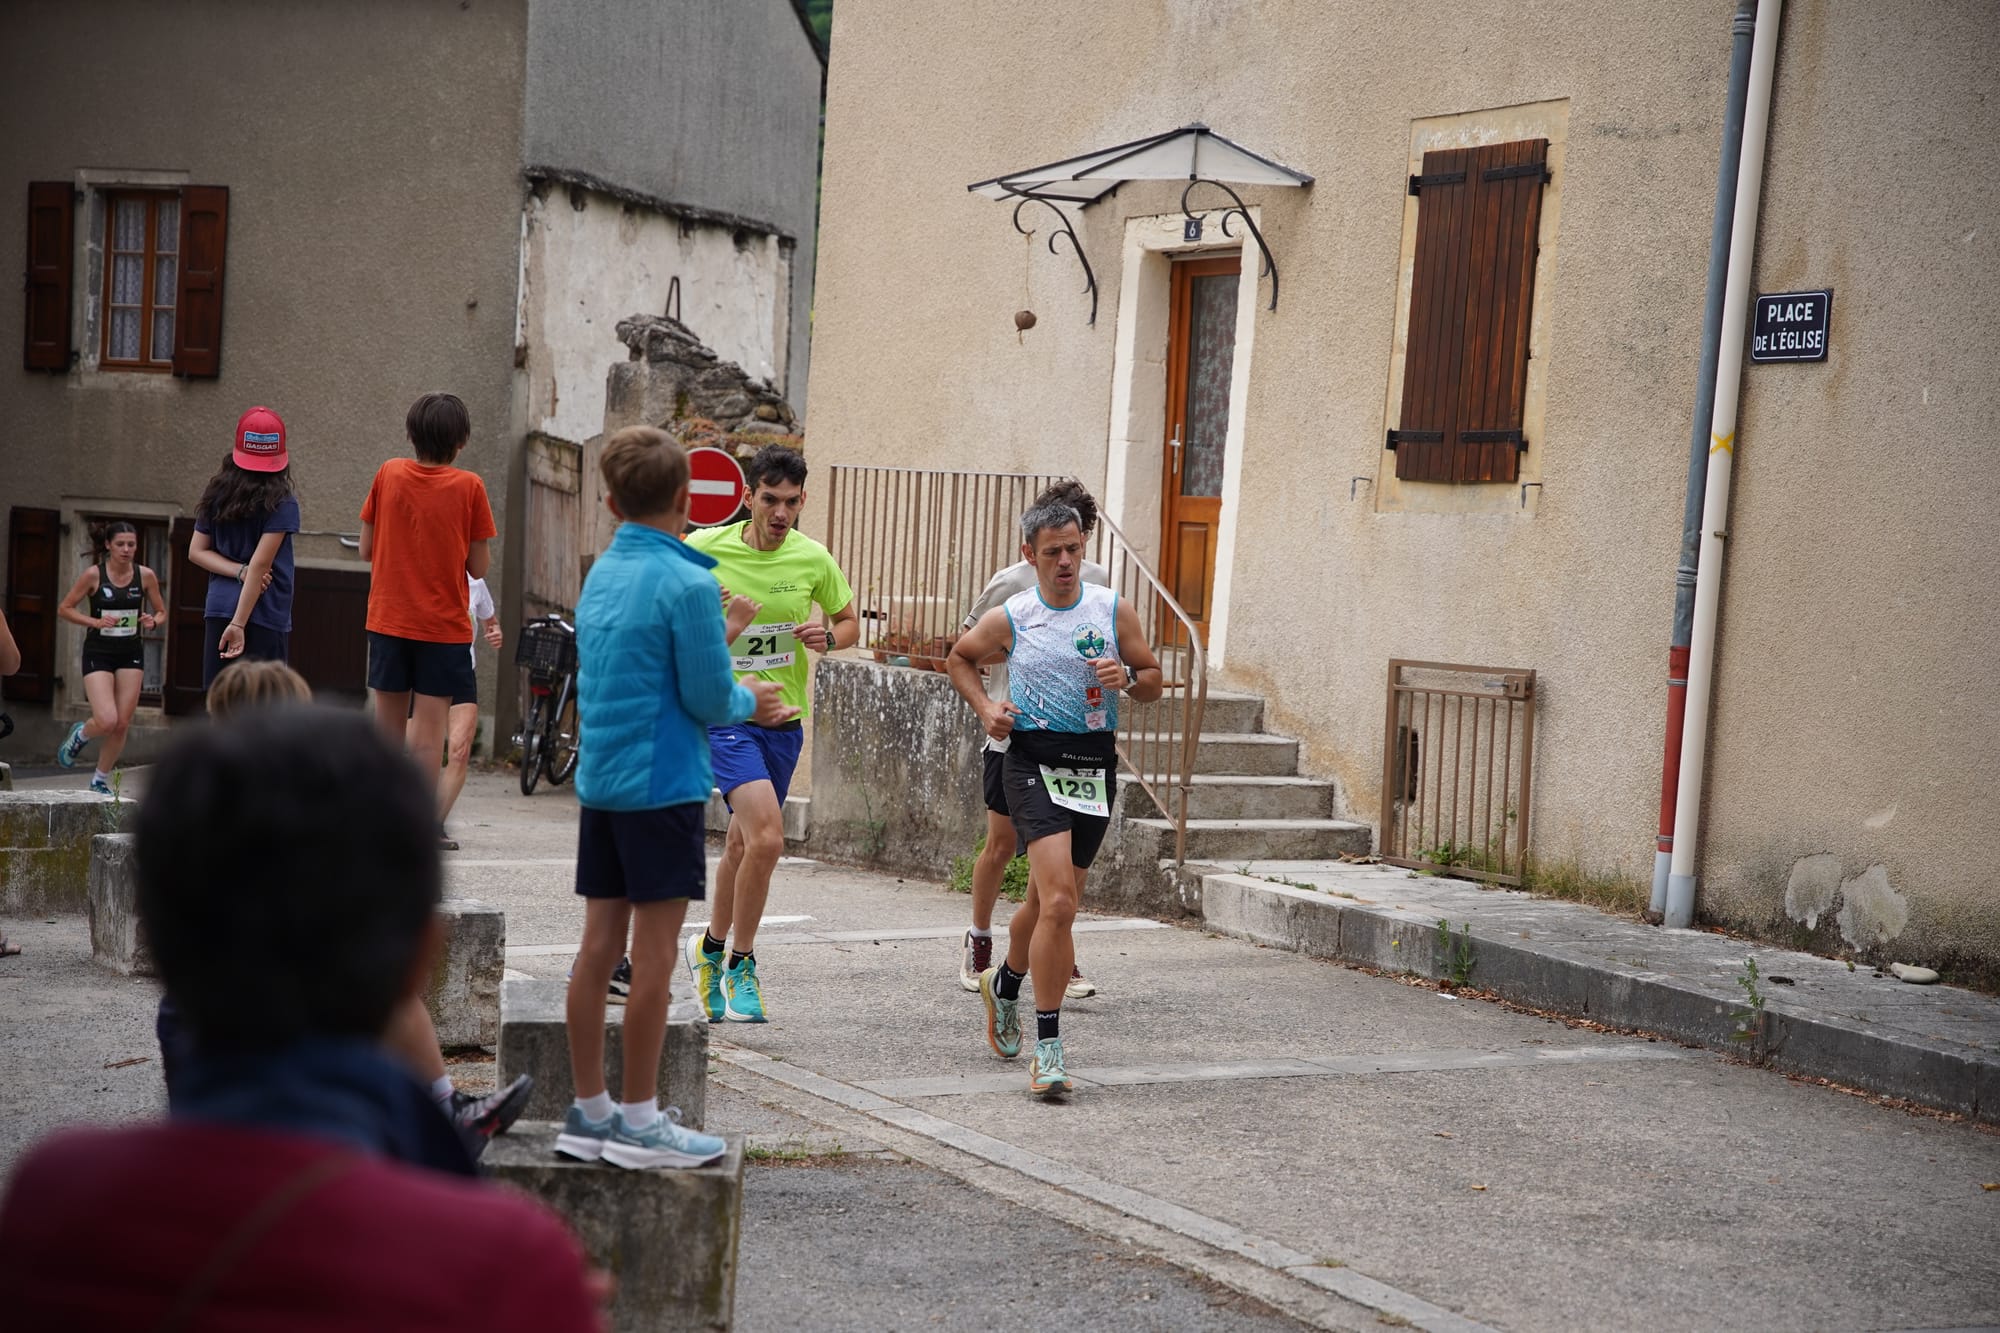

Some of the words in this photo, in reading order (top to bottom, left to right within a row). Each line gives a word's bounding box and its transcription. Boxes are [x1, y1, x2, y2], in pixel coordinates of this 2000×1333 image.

[1189, 222, 1196, 237] 6
[1768, 302, 1814, 322] PLACE
[1755, 335, 1767, 351] DE
[1770, 327, 1822, 350] L'ÉGLISE
[246, 442, 277, 450] GASGAS
[748, 635, 777, 655] 21
[1052, 778, 1097, 801] 129
